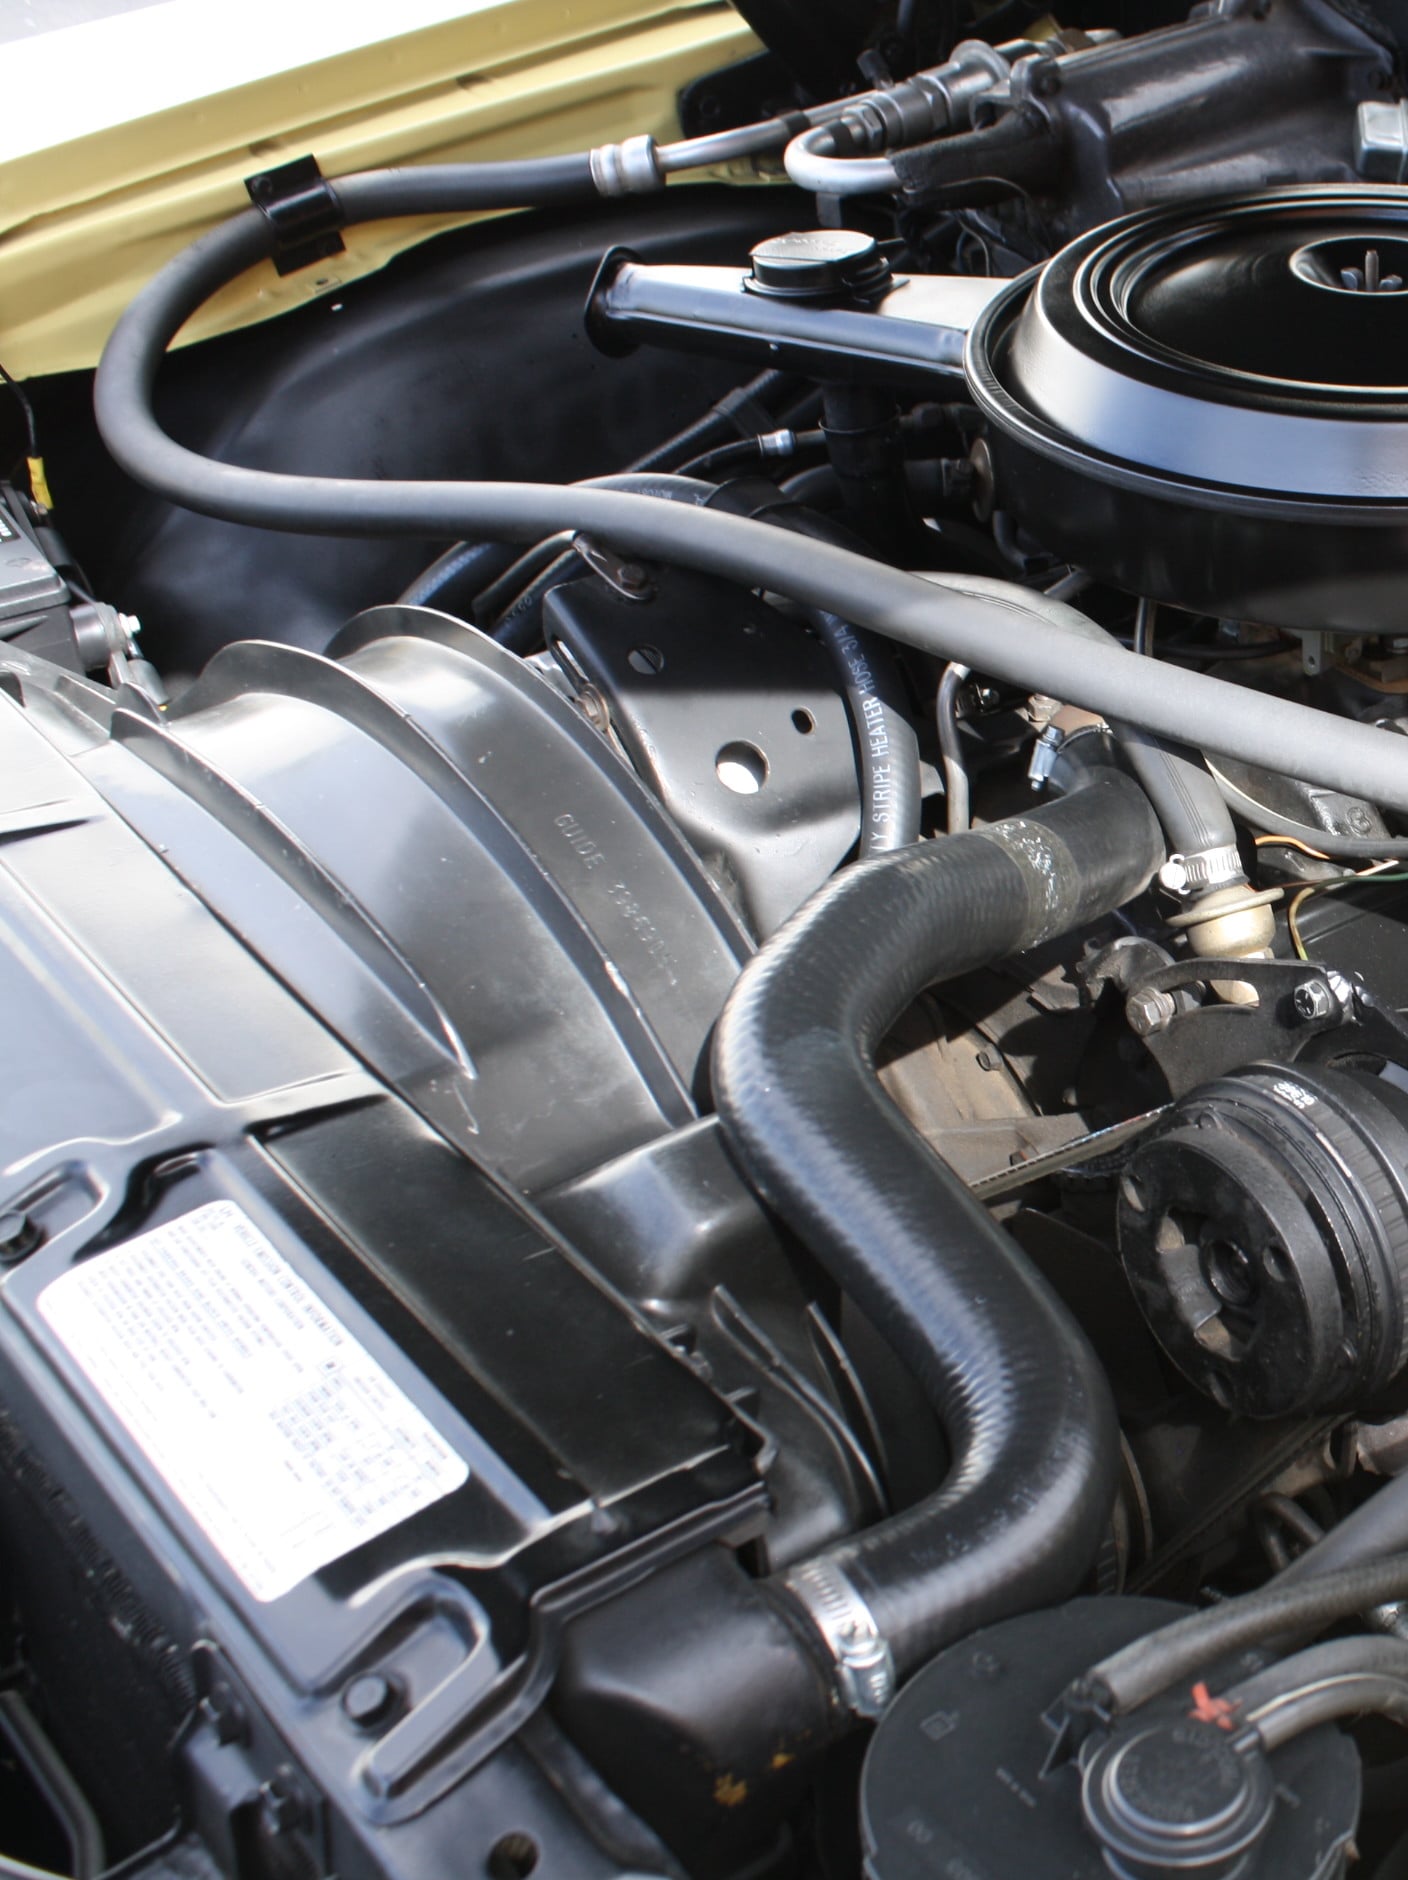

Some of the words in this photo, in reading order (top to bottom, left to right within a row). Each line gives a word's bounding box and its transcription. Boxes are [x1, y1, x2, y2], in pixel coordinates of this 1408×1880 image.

[834, 625, 858, 655] 3/4
[848, 654, 876, 695] HOSE
[862, 697, 890, 757] HEATER
[873, 765, 890, 823] STRIPE
[554, 813, 606, 870] GUIDE
